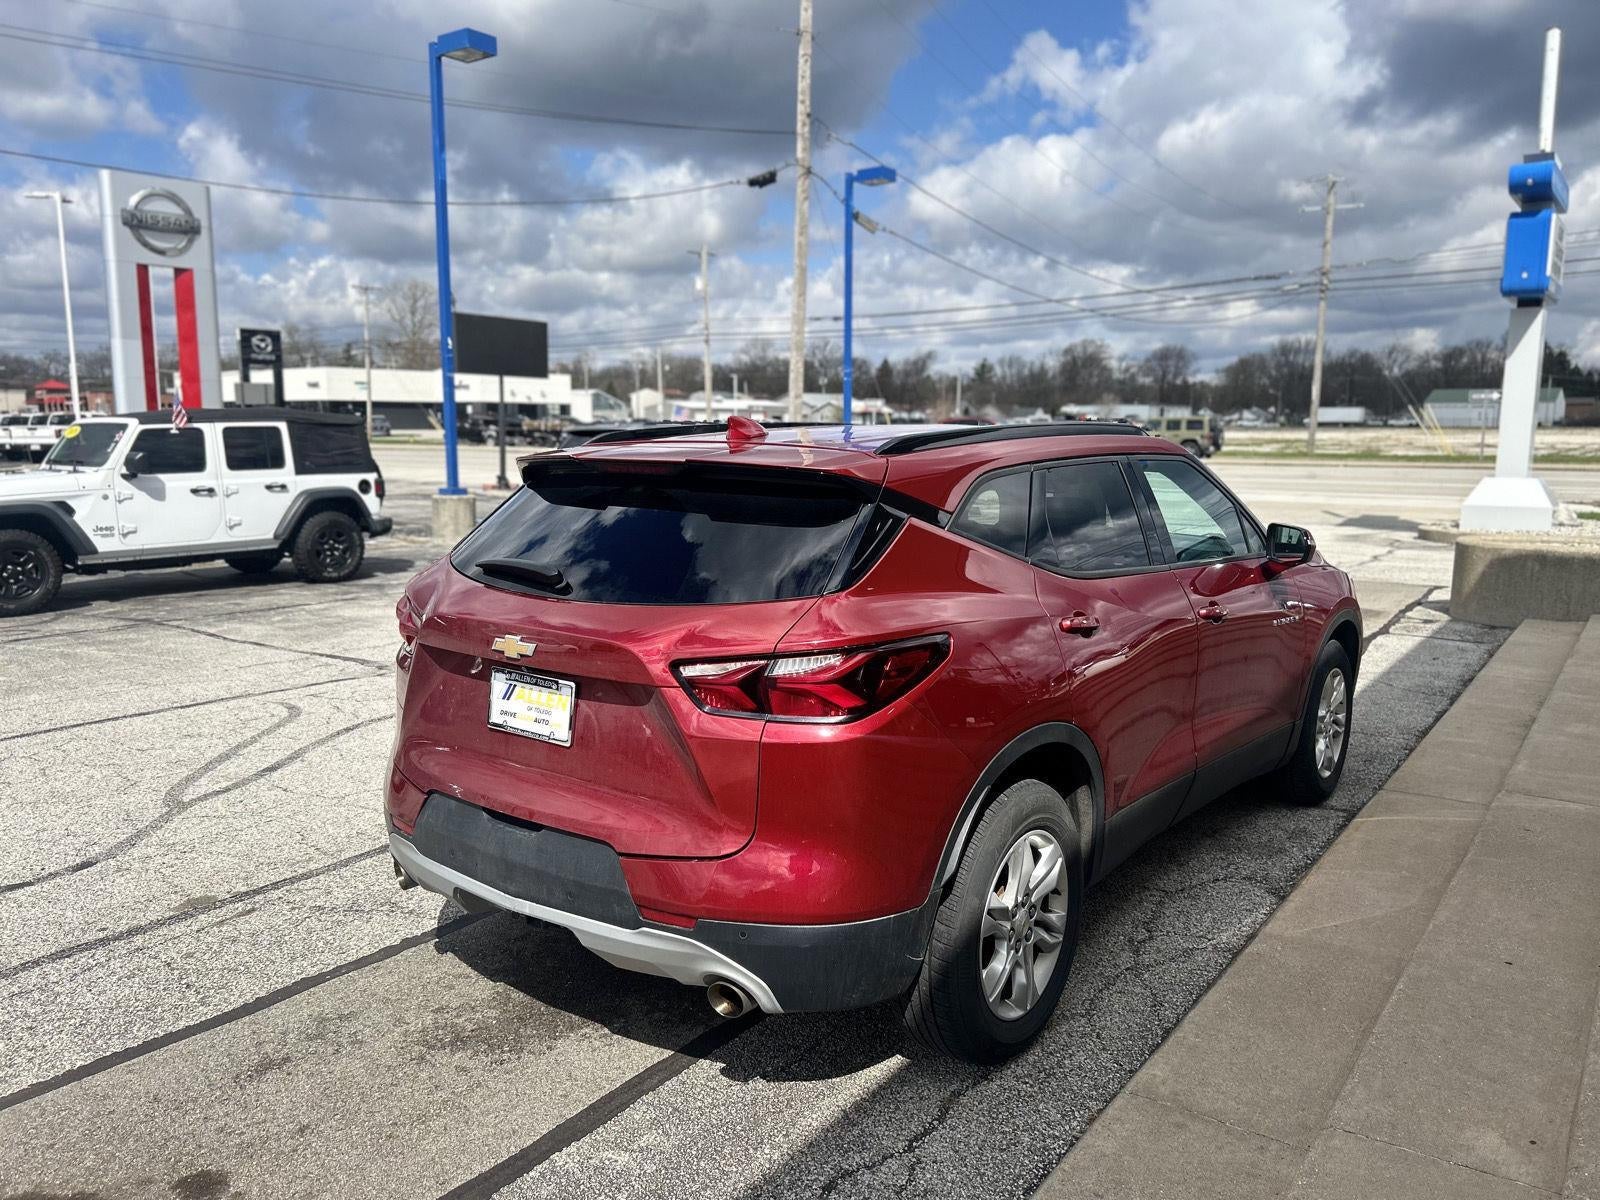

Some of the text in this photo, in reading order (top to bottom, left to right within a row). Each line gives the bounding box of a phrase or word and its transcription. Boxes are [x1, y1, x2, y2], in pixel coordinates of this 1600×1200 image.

[130, 212, 195, 231] NISSAN
[92, 525, 115, 533] Jeep
[515, 673, 531, 684] ALLEN
[537, 679, 555, 688] TOLEDO
[515, 686, 570, 712] ALLEN
[534, 707, 553, 716] TOLEDO
